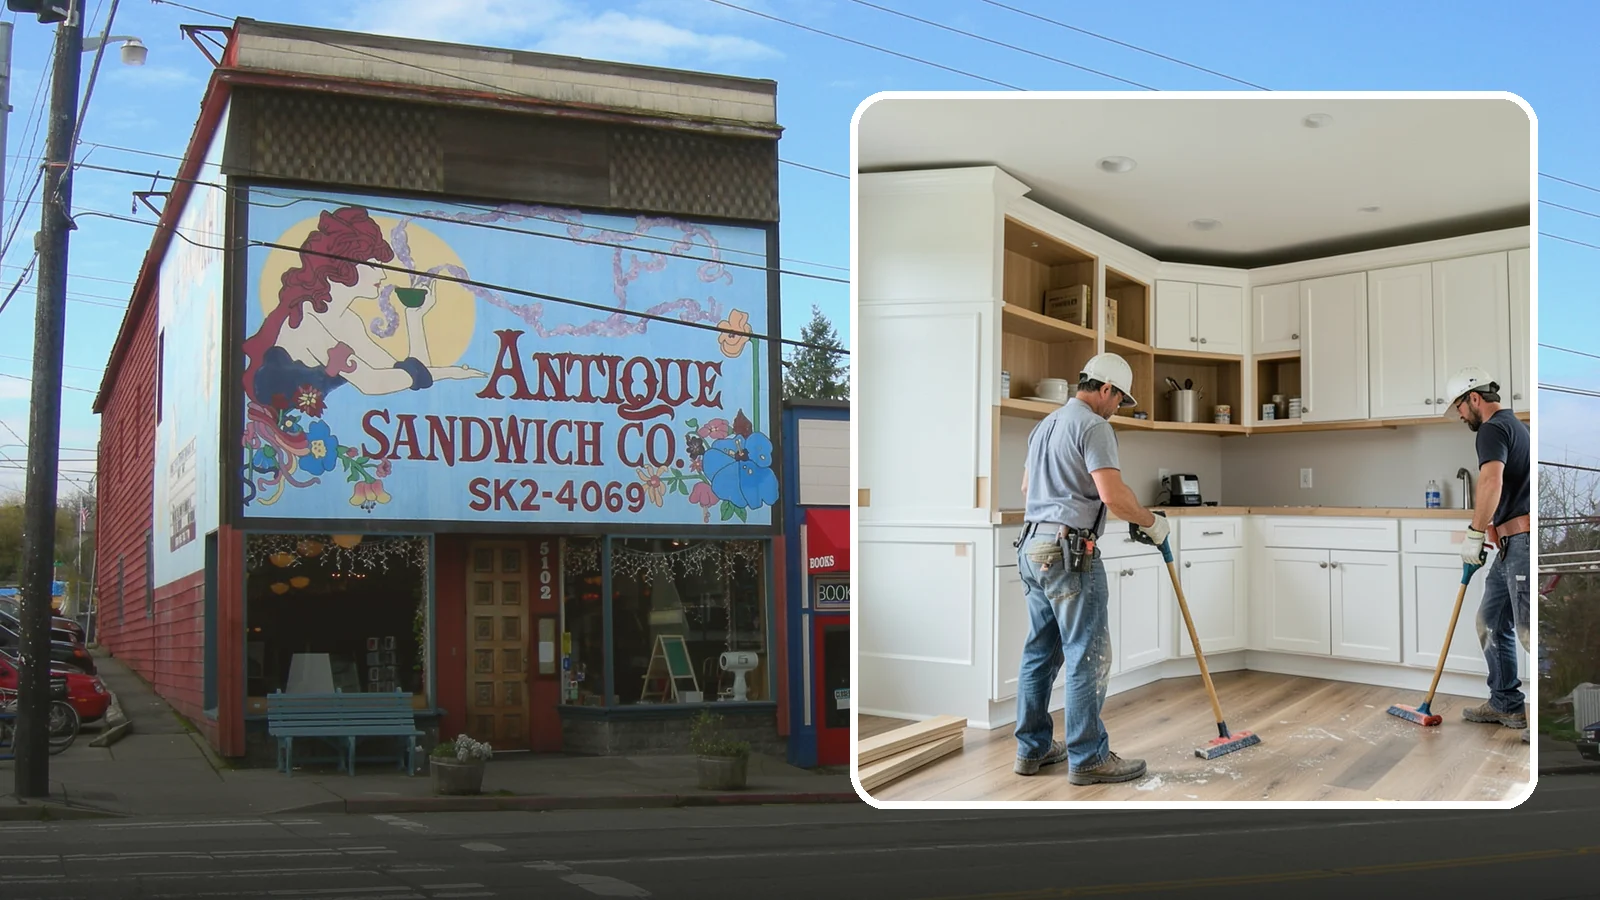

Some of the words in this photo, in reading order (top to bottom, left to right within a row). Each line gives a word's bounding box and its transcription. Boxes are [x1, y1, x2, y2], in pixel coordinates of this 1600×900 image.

[476, 329, 723, 420] ANTIQUE
[362, 409, 604, 466] SANDWICH
[616, 421, 685, 468] CO.
[468, 477, 646, 513] SK2-4069
[540, 541, 551, 599] 5102
[809, 555, 834, 569] BOOKS
